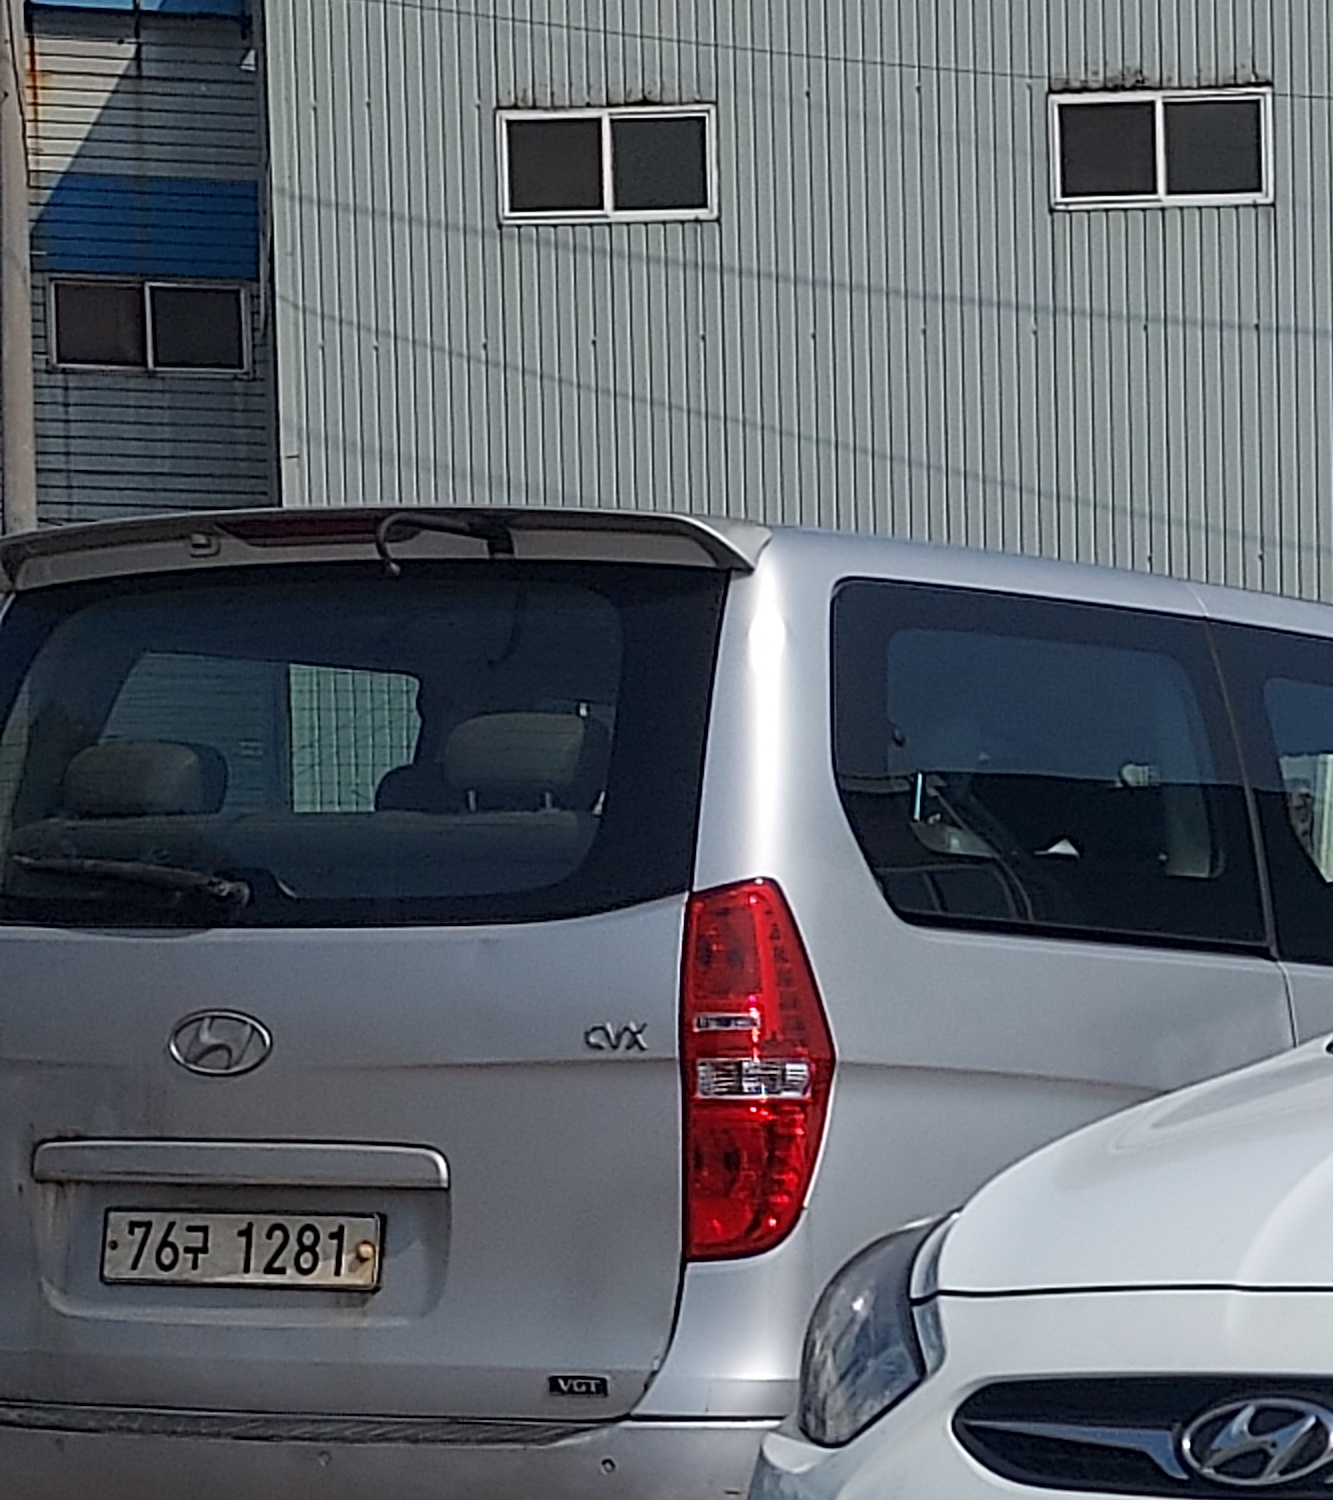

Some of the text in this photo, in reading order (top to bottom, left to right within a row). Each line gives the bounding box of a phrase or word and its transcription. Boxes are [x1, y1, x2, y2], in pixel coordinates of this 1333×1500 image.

[584, 1022, 648, 1051] CVX
[127, 1220, 346, 1277] 76구 1281
[557, 1377, 601, 1393] VGT
